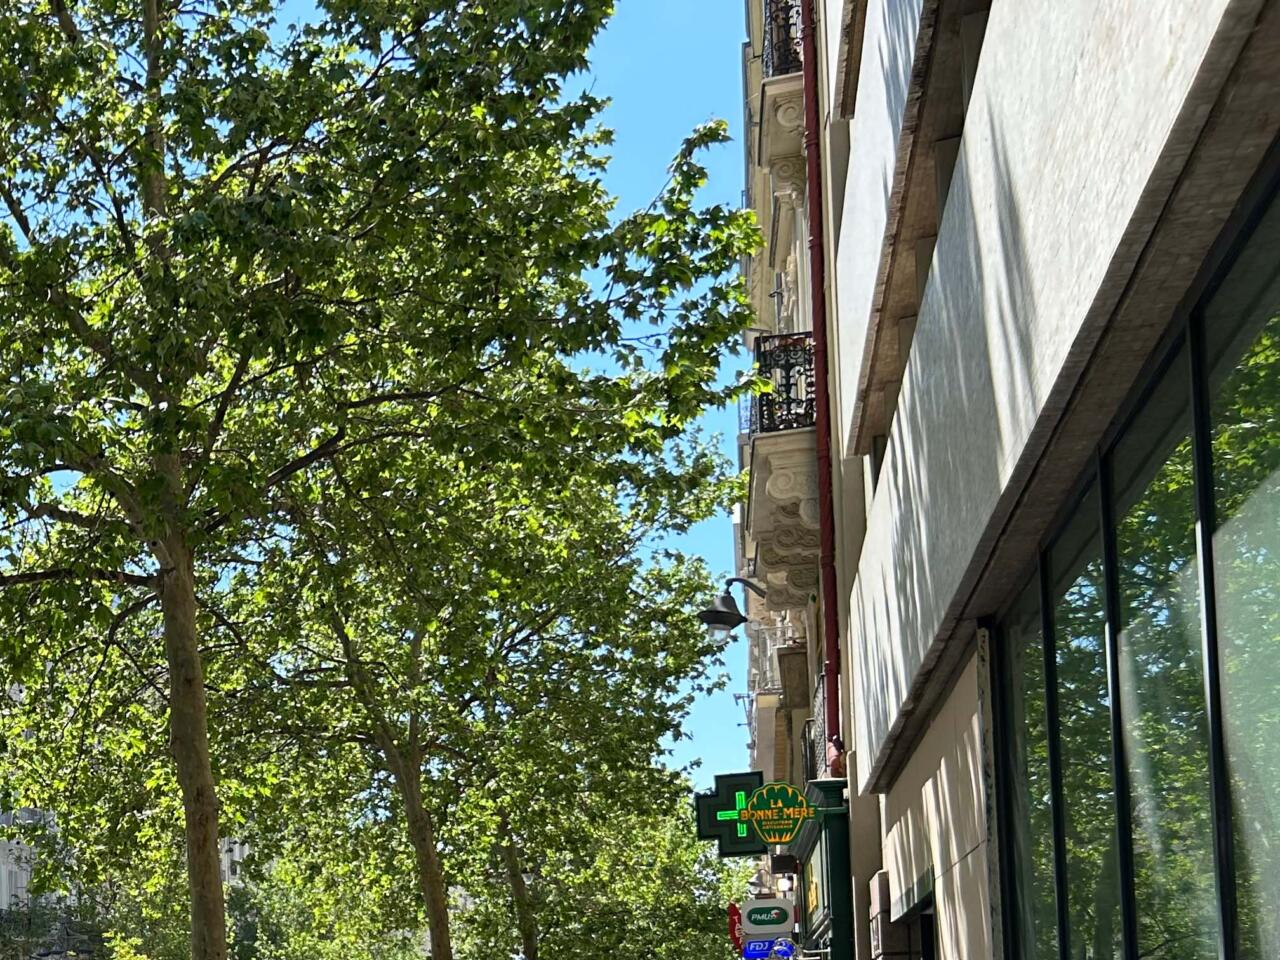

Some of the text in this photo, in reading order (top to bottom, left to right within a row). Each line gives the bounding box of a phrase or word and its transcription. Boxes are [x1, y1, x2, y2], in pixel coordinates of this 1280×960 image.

[770, 799, 783, 808] LA
[751, 913, 772, 921] PMU
[749, 942, 769, 951] FDJ
